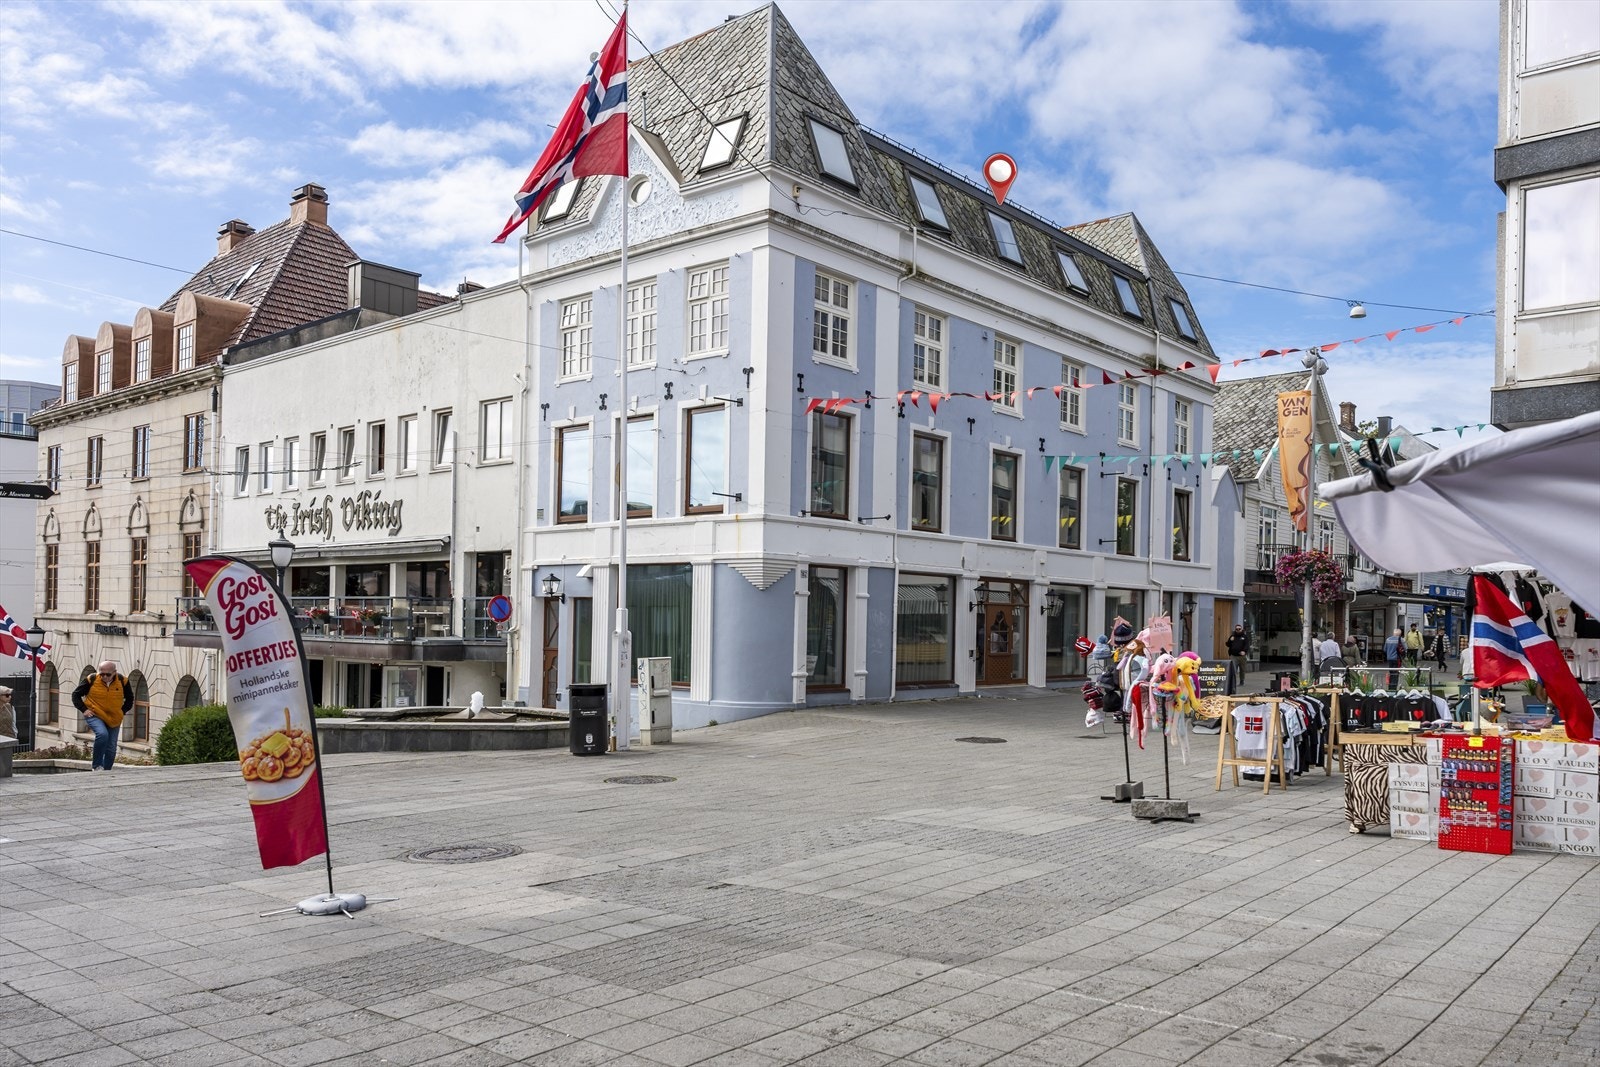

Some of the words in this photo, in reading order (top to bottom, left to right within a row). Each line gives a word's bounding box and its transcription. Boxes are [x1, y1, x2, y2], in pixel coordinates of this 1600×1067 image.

[1281, 396, 1306, 408] VAN
[1282, 406, 1308, 417] GEN
[264, 504, 288, 531] The
[290, 494, 334, 540] Irish
[340, 489, 403, 537] Viking
[217, 573, 267, 610] Gosi
[225, 593, 278, 641] Gosi
[240, 669, 290, 689] Hollandske
[233, 680, 300, 704] minipannekaker
[1558, 760, 1595, 768] VAULEN
[1514, 784, 1550, 794] GAUSEL
[1556, 789, 1594, 799] FOGN
[1392, 805, 1425, 814] SULDAL
[1516, 814, 1554, 822] STRAND
[1557, 817, 1596, 826] HAUGESUND
